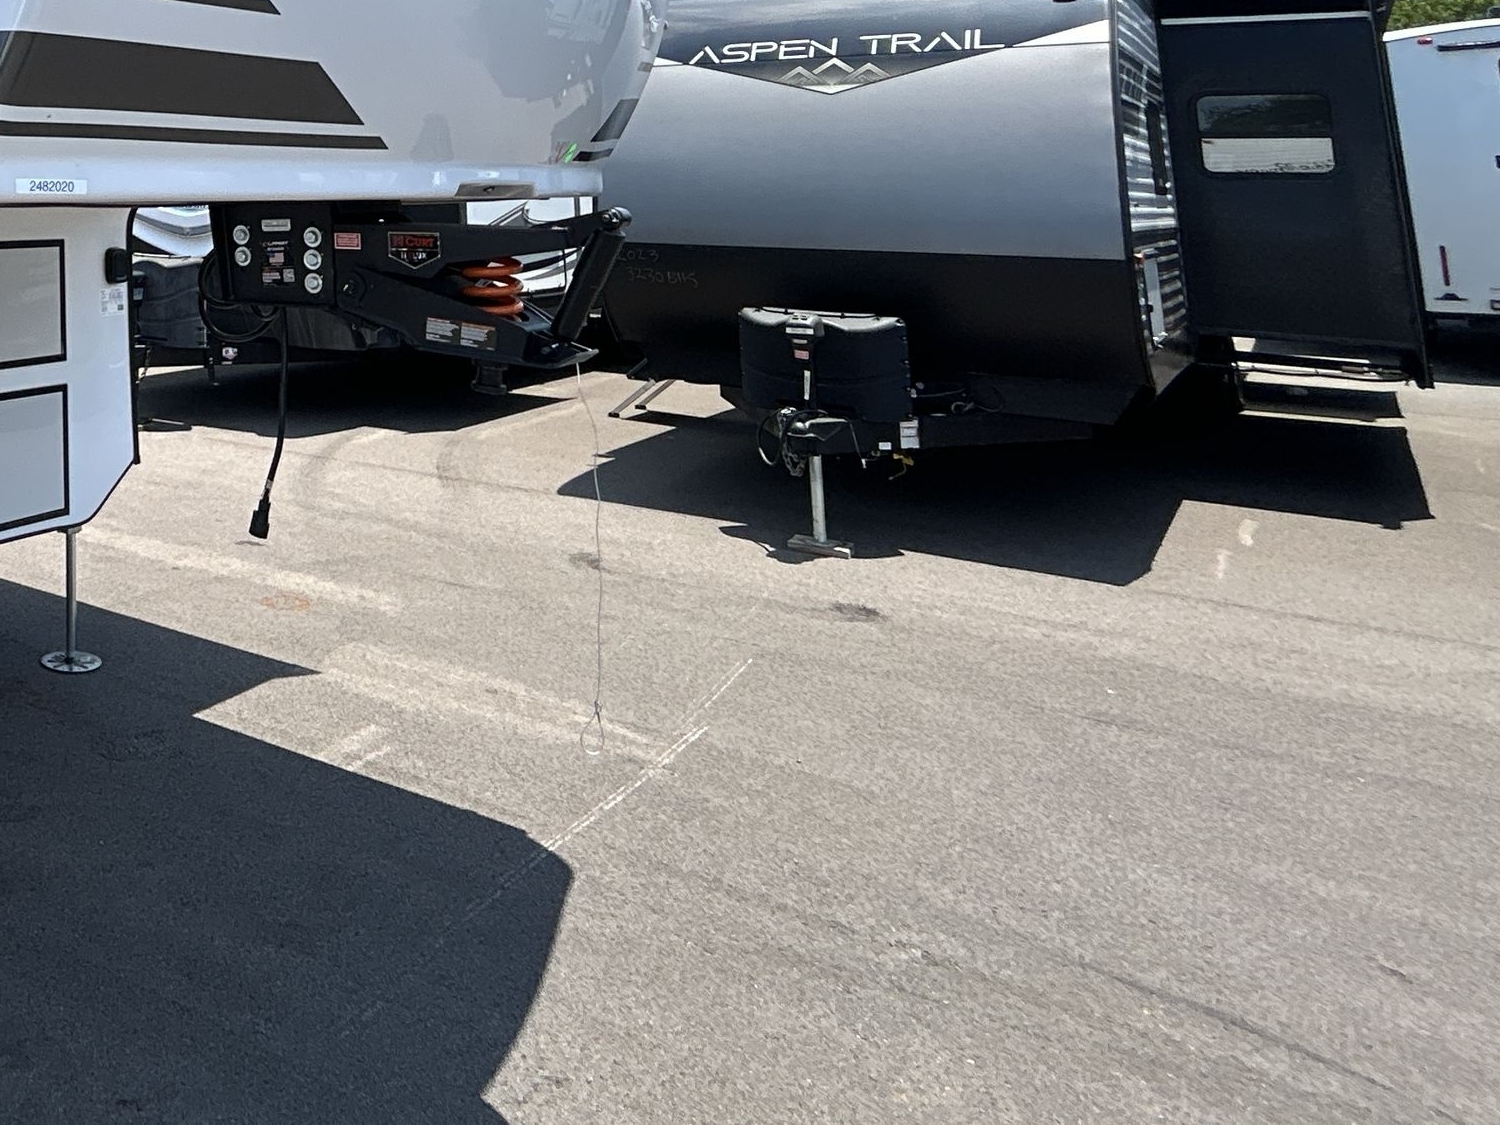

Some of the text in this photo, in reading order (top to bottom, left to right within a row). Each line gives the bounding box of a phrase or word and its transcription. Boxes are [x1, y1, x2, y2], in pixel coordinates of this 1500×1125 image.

[688, 28, 1006, 65] ASPEN TRAIL
[29, 180, 75, 193] 2482020
